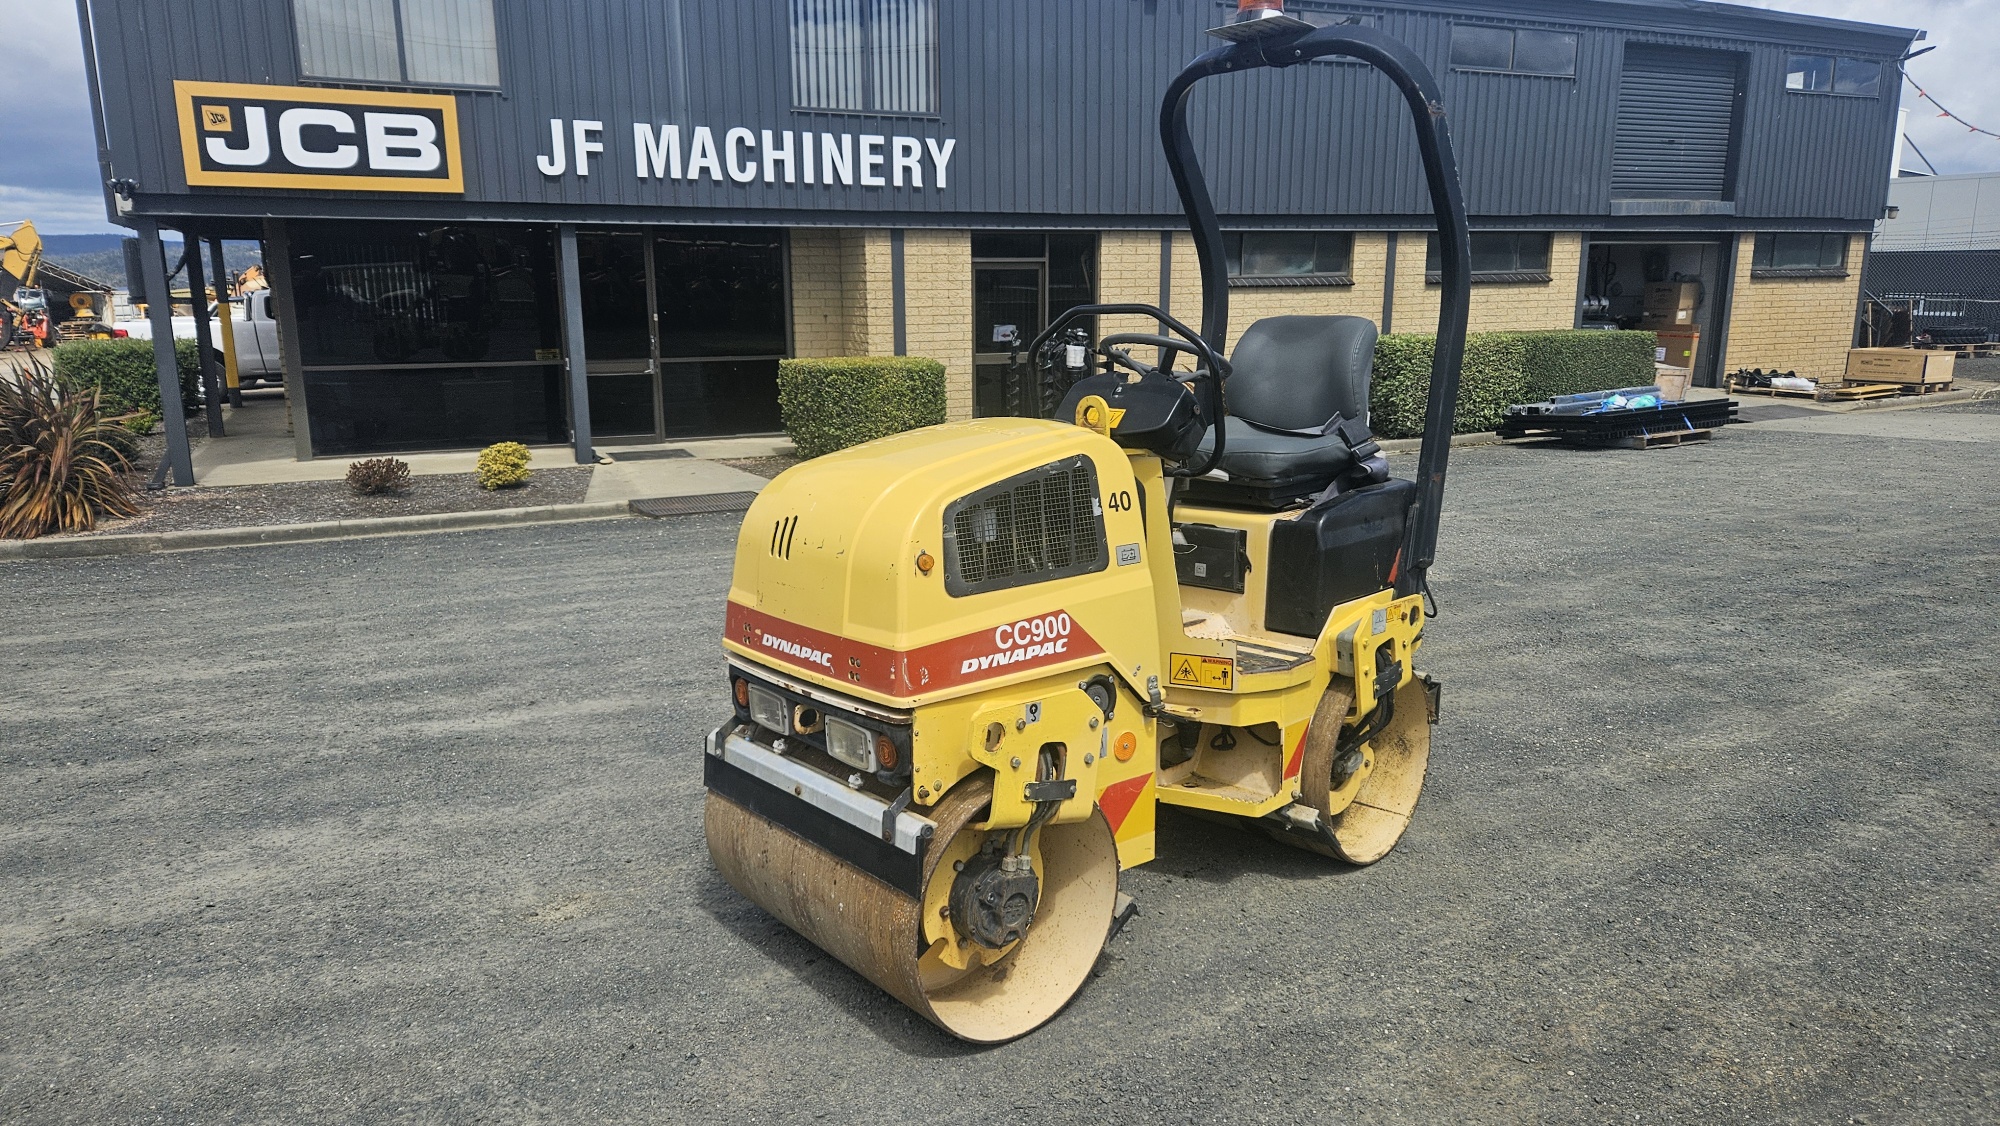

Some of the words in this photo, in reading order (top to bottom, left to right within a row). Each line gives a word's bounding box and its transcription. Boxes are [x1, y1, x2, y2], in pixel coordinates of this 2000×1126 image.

[210, 112, 226, 124] JCB
[205, 106, 441, 171] JCB
[537, 118, 603, 176] JF
[633, 122, 956, 188] MACHINERY
[1109, 490, 1131, 512] 40
[995, 613, 1071, 649] CC900
[762, 633, 832, 667] DYNAPAC
[960, 638, 1068, 674] DYNAPAC
